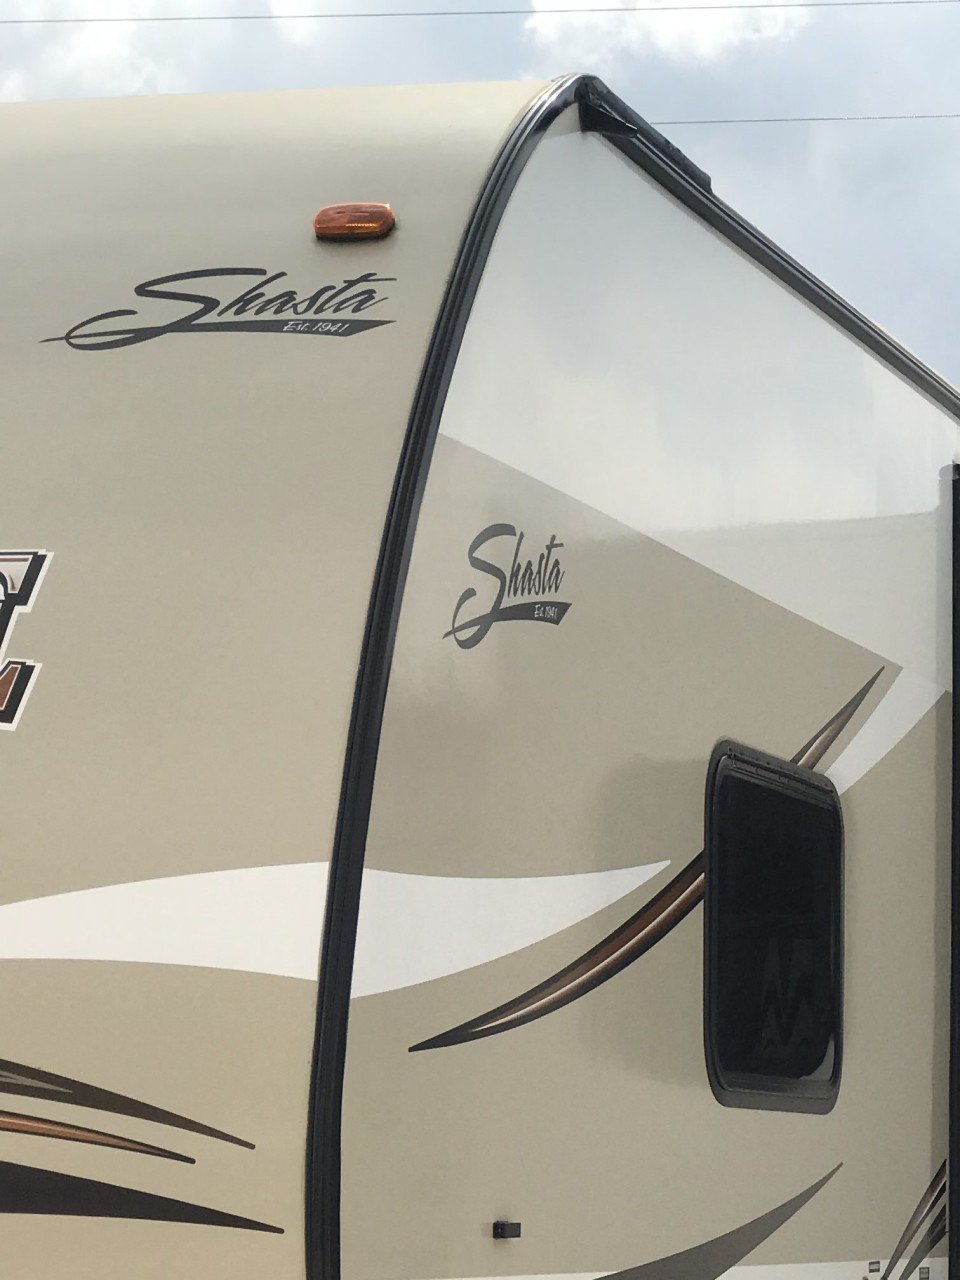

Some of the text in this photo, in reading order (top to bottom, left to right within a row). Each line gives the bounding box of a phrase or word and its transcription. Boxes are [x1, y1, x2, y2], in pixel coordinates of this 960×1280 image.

[39, 267, 397, 351] Shasta
[312, 321, 350, 333] 1941
[442, 523, 572, 650] Shasta
